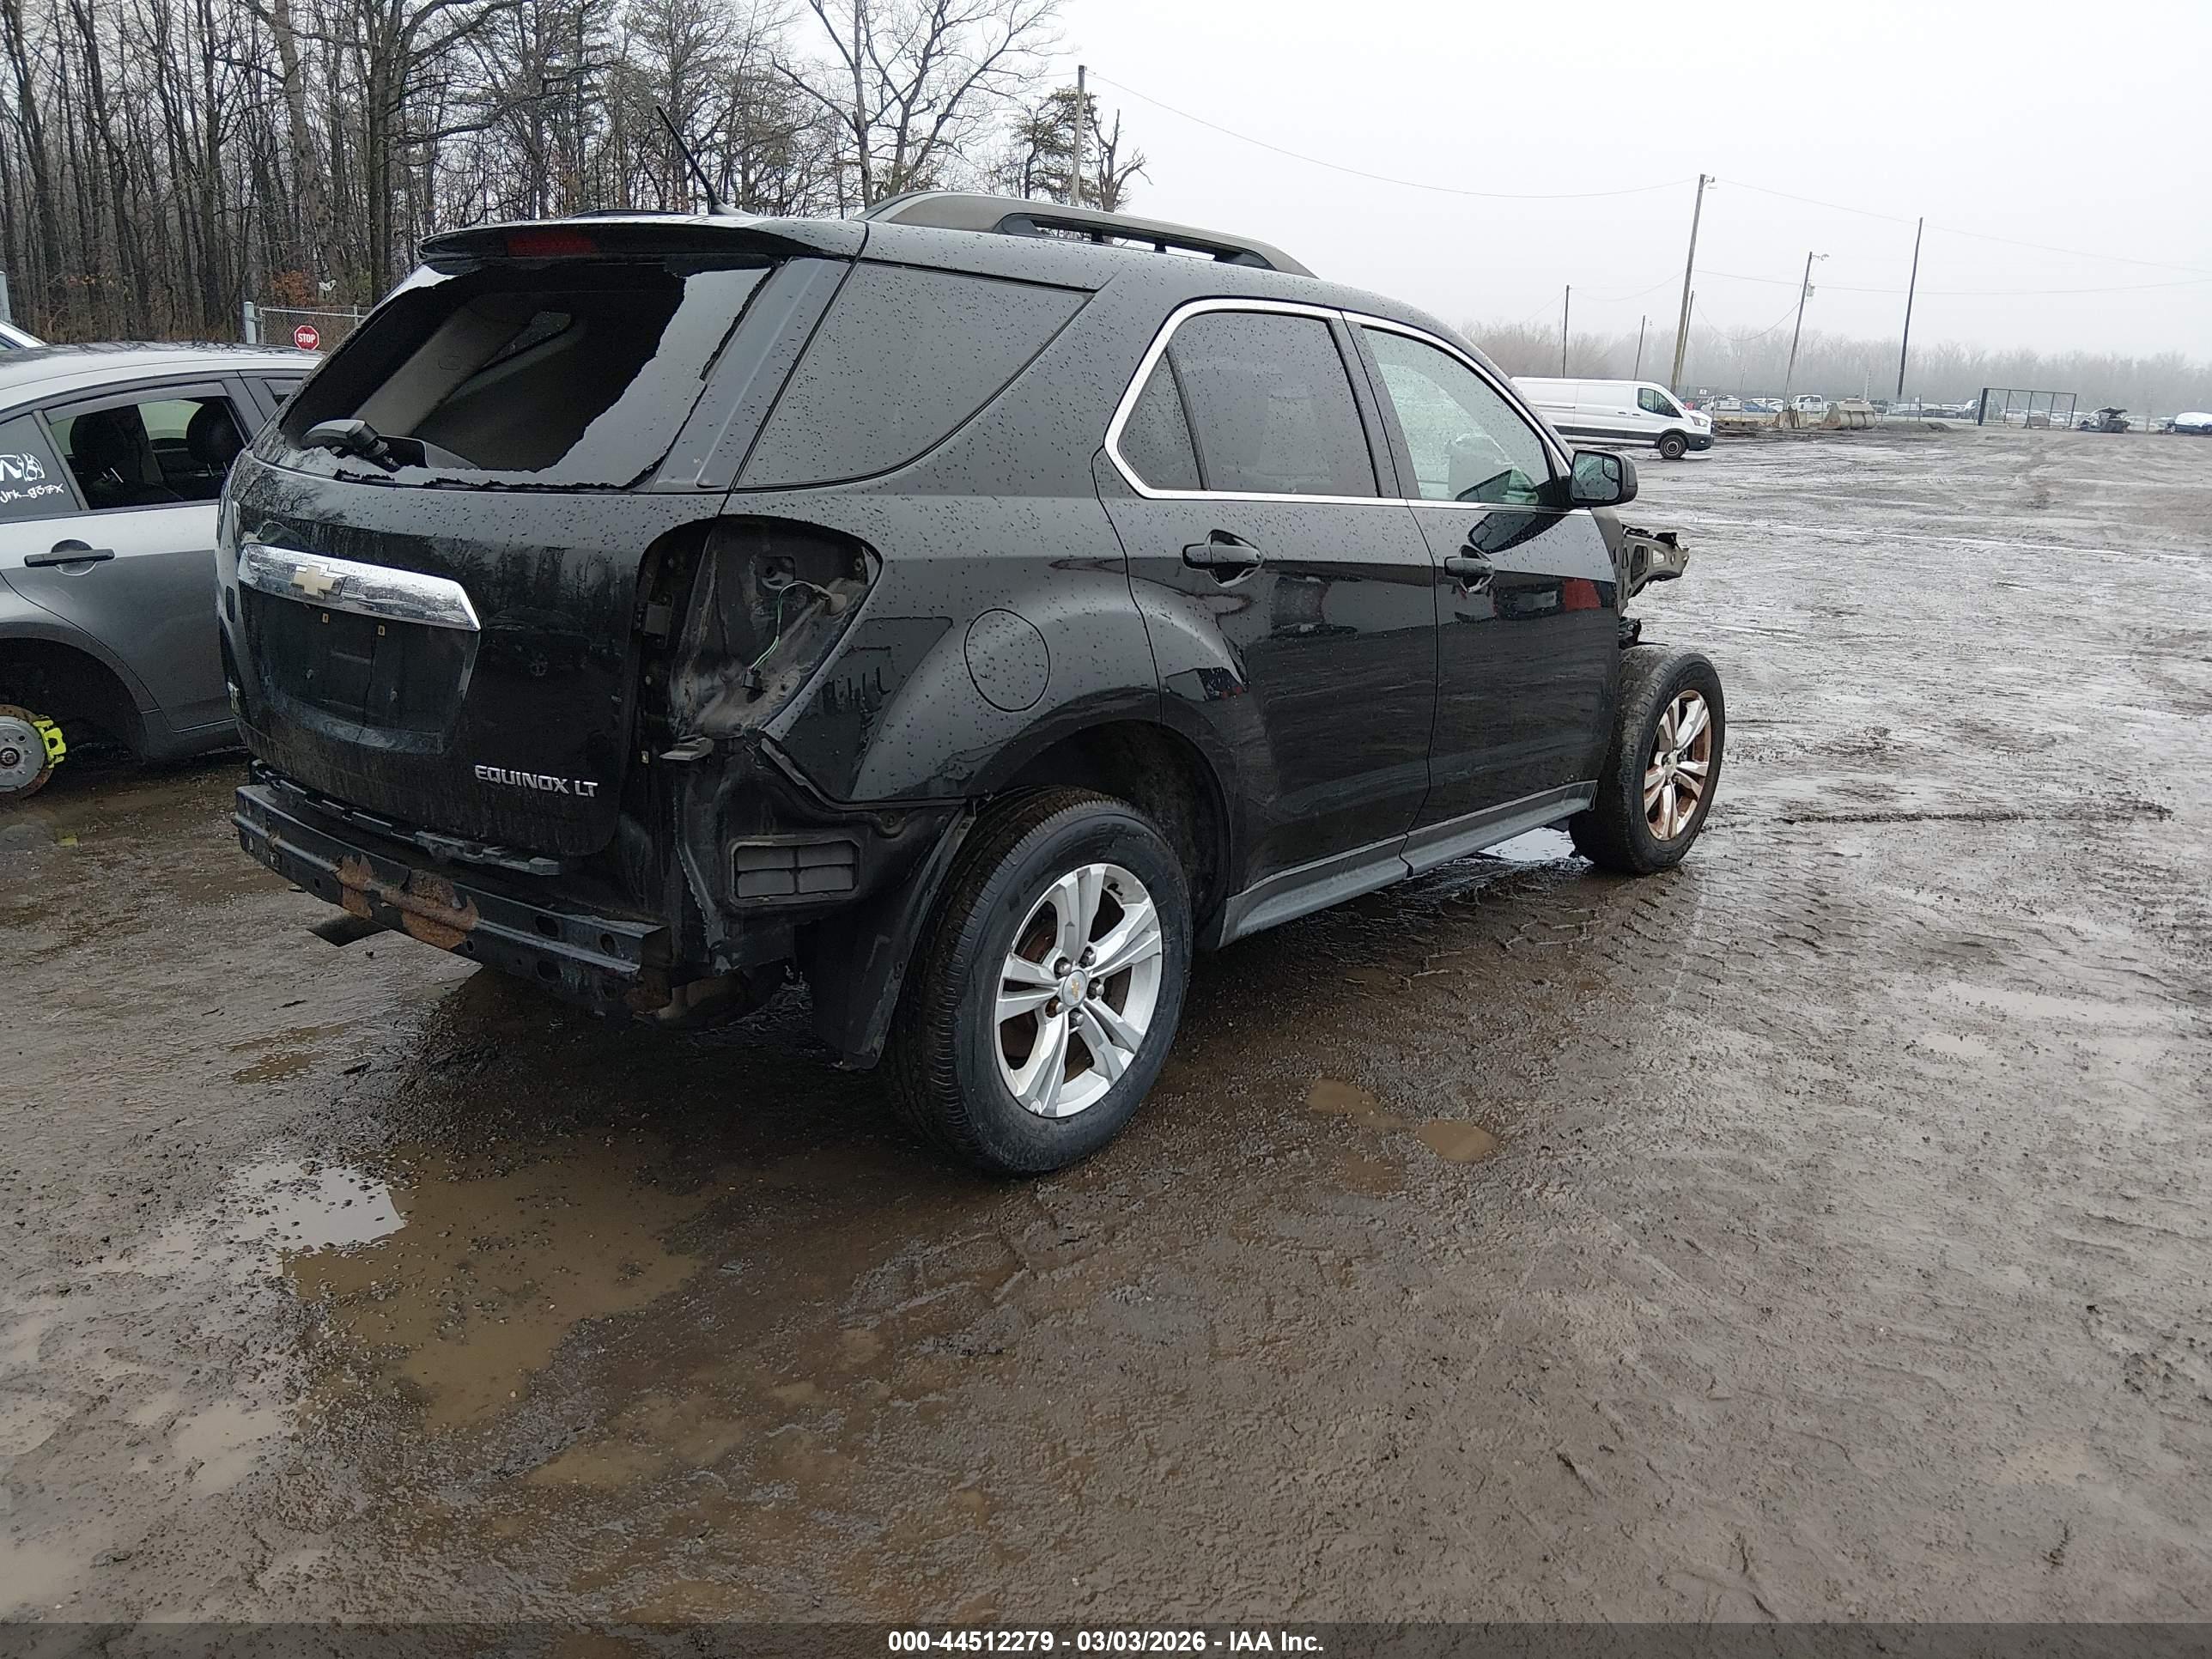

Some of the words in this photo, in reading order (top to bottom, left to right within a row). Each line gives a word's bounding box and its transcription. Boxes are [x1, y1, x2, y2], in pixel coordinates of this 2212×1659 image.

[298, 333, 316, 343] STOP
[474, 764, 569, 794] EQUINOX
[574, 780, 599, 797] LT
